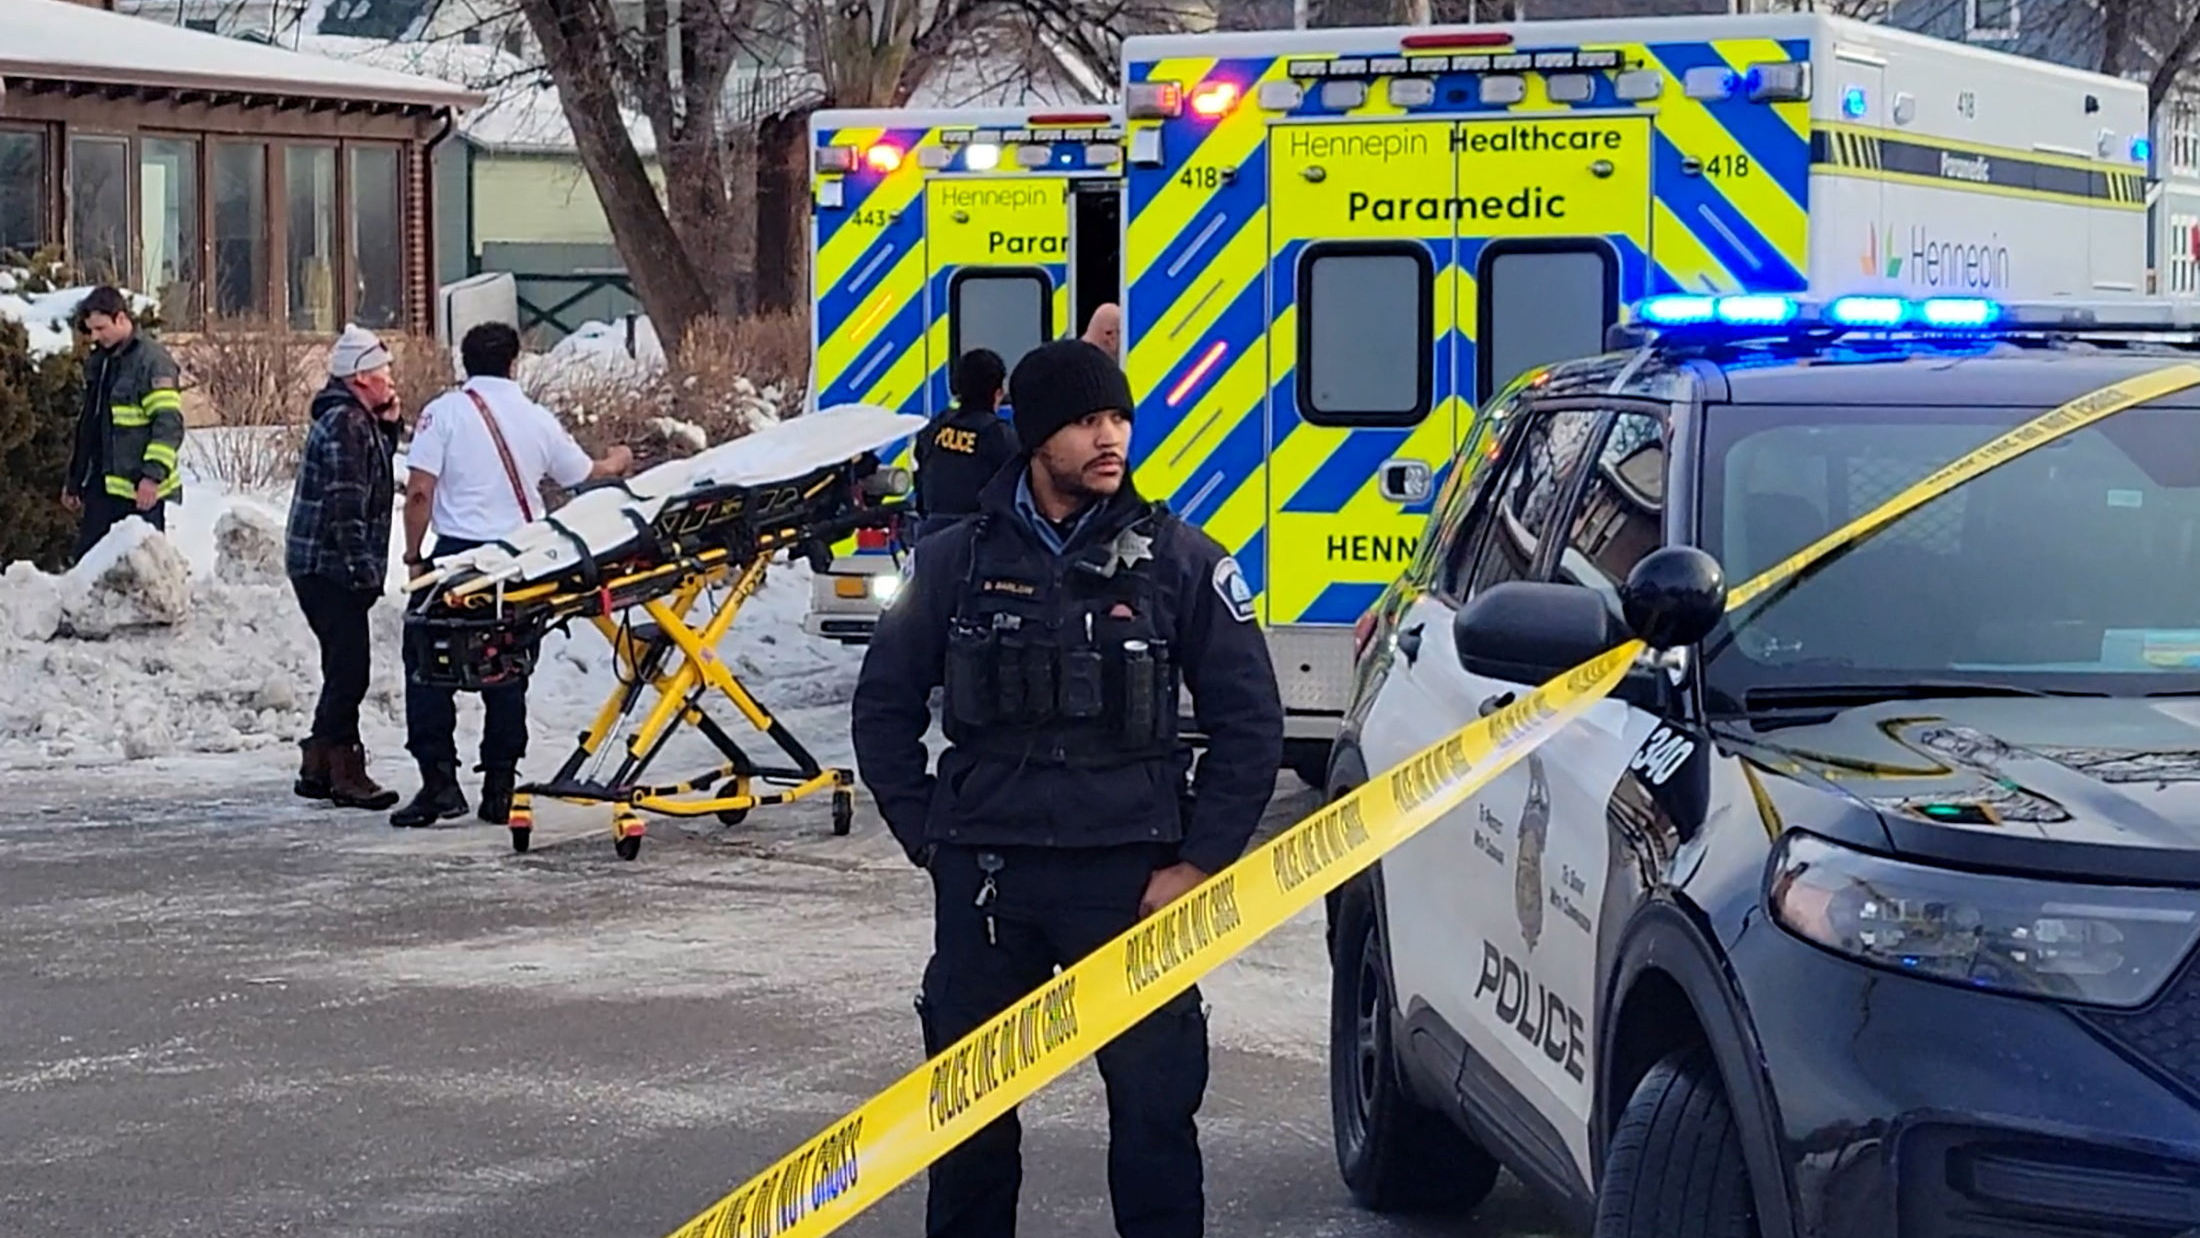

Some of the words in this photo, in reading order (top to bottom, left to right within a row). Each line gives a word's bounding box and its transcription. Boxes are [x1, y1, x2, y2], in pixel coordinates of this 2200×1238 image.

[1291, 128, 1427, 162] Hennepin
[1450, 124, 1622, 153] Healthcare
[1180, 166, 1217, 188] 418
[1705, 154, 1749, 178] 418
[942, 185, 1047, 211] Hennepin
[1349, 187, 1566, 221] Paramedic
[852, 210, 886, 227] 443
[1911, 225, 2009, 290] Hennepin
[934, 426, 978, 454] POLICE
[1631, 726, 1695, 786] 340
[1125, 923, 1160, 996] POLICE
[1474, 938, 1586, 1084] POLICE
[929, 1043, 972, 1132] POLICE
[972, 1025, 999, 1101] LINE
[1000, 1013, 1017, 1082] DO
[1018, 997, 1041, 1070] NOT
[1042, 975, 1078, 1053] CROSS
[750, 1171, 779, 1238] DO
[777, 1148, 815, 1235] NOT
[811, 1115, 863, 1211] CROSS
